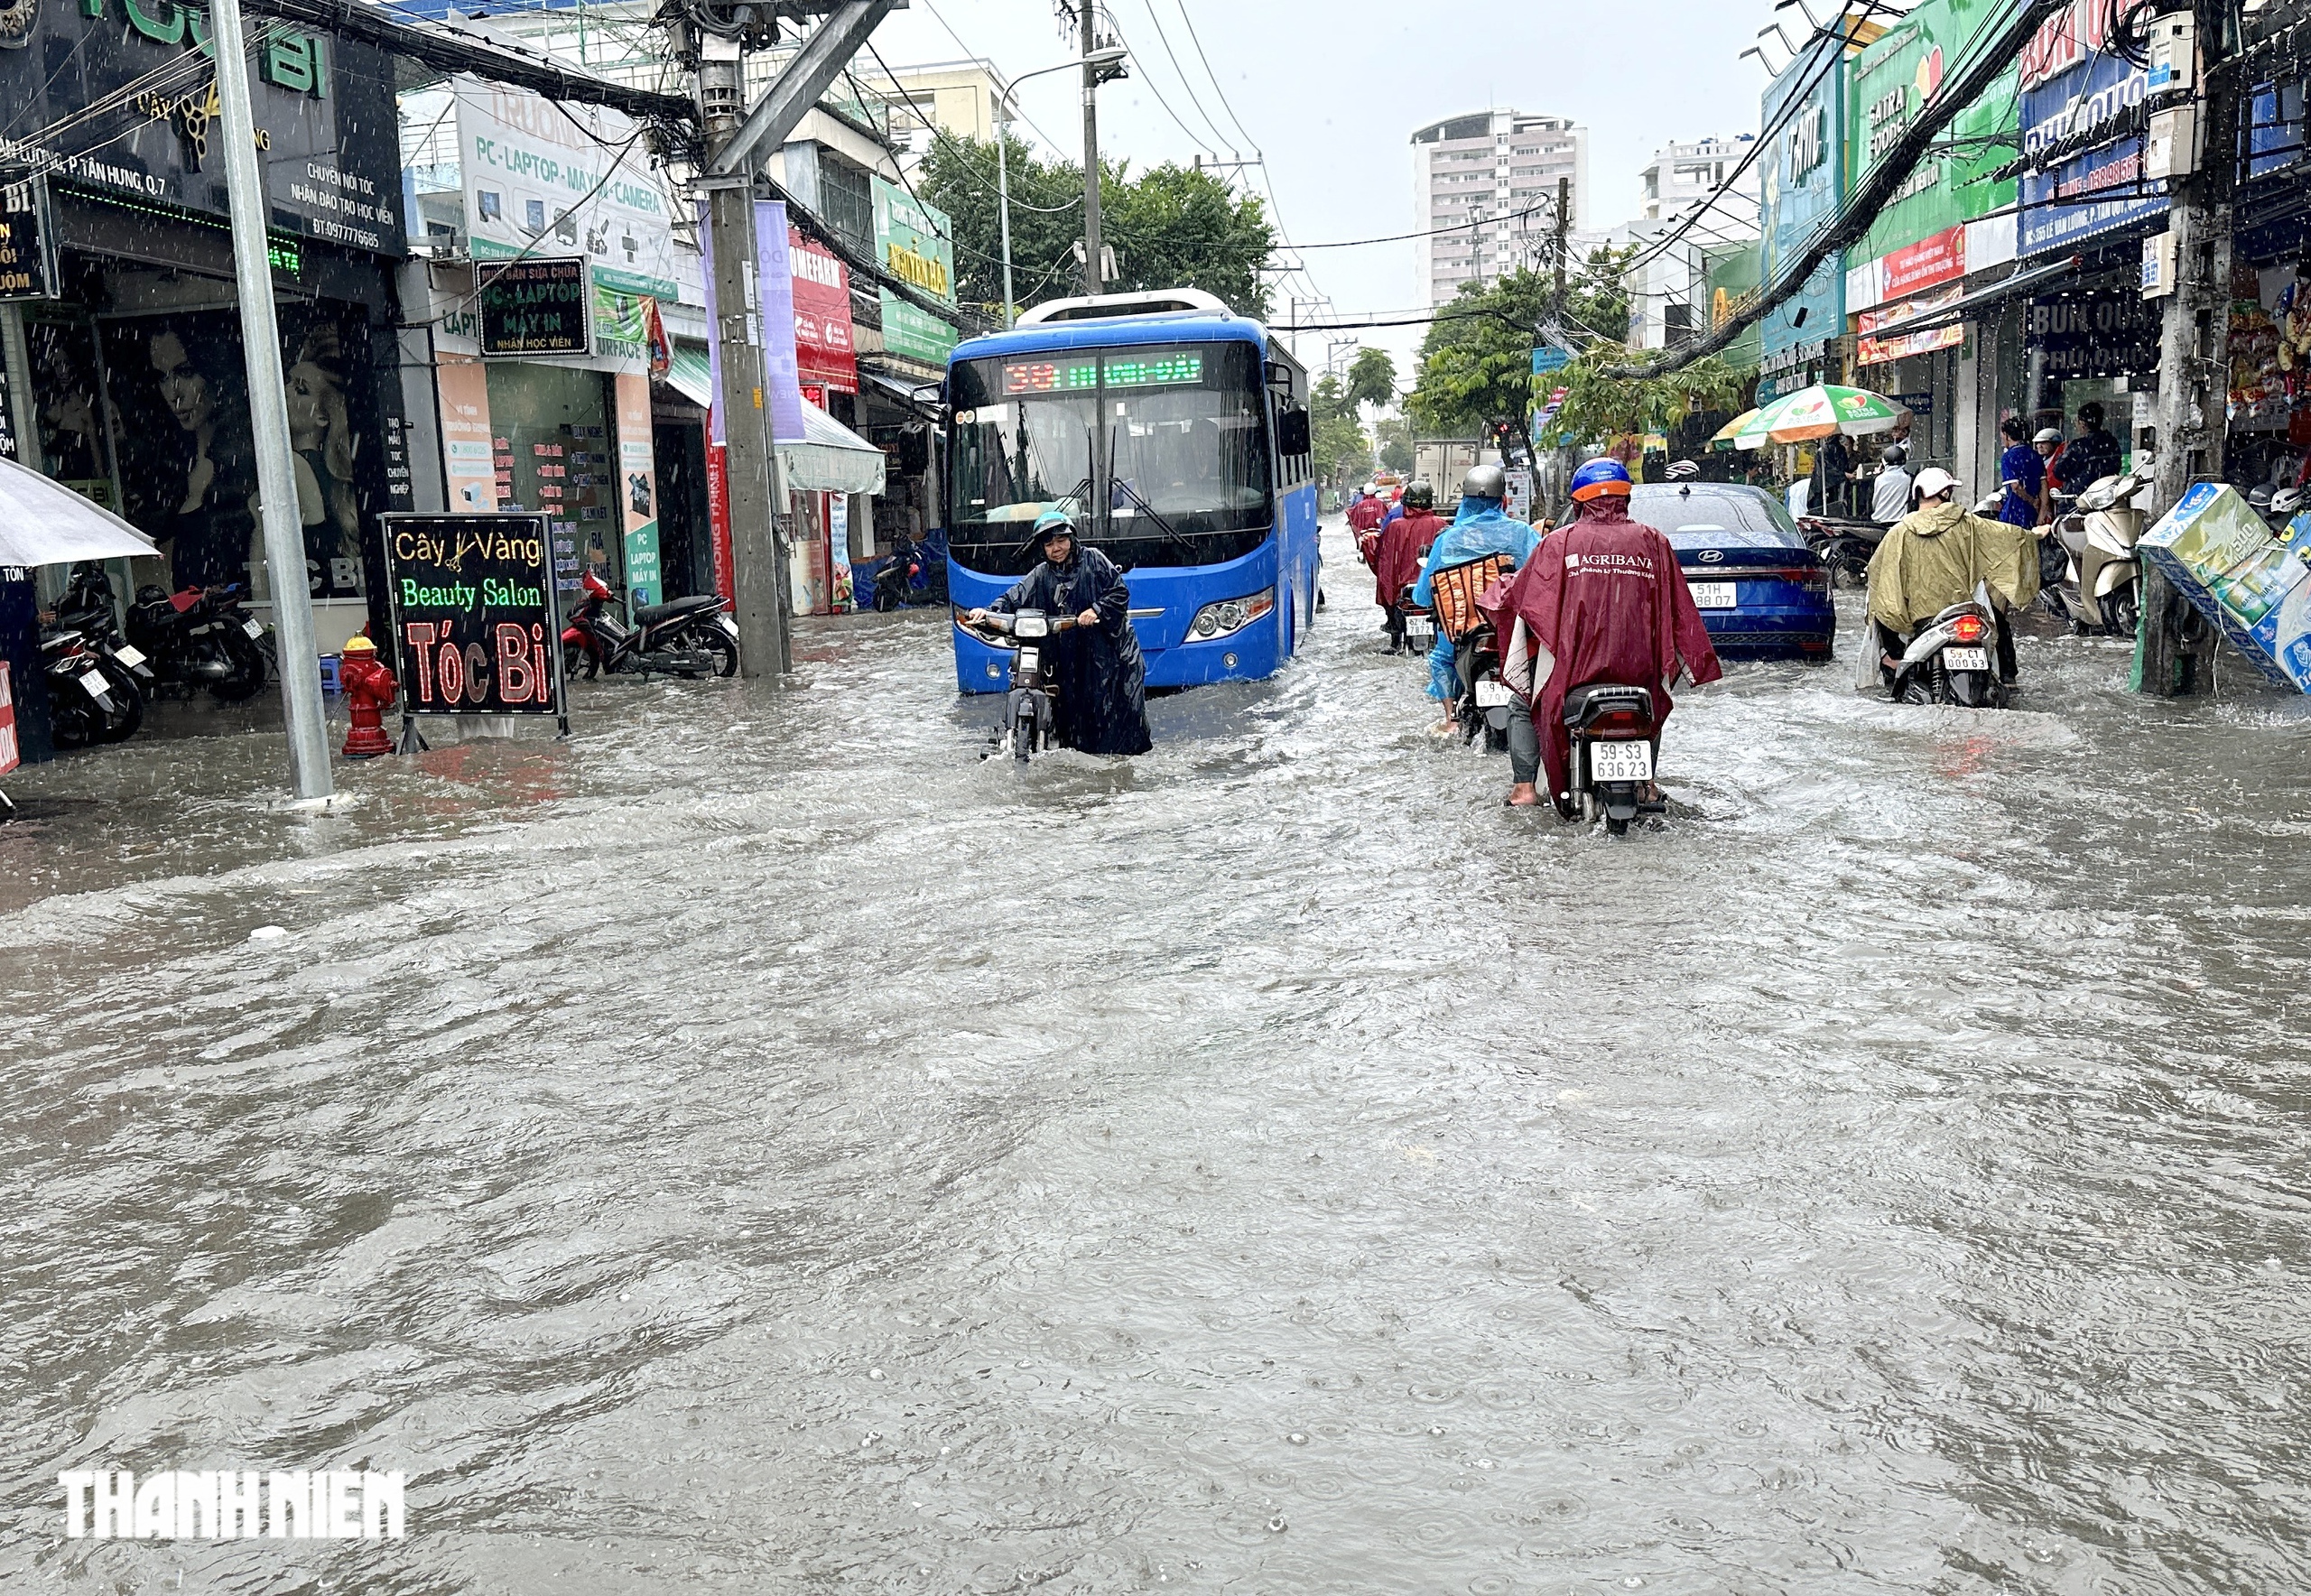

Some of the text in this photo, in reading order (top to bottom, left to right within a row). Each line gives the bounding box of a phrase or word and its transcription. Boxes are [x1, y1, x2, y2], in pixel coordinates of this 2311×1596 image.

[307, 162, 341, 187] CHUYÊN
[358, 176, 375, 195] TÓC
[291, 183, 394, 226] NHẬN ĐÀO TẠO HỌC VIÊN
[516, 283, 581, 303] LAPTOP
[503, 311, 562, 334] MÁY IN
[2033, 298, 2088, 334] BÚN
[526, 338, 548, 349] HỌC
[550, 337, 571, 348] VIÊN
[637, 534, 647, 545] PC
[2232, 523, 2256, 552] 500
[395, 532, 543, 567] Cây Vàng
[631, 552, 656, 564] LAPTOP
[1581, 554, 1654, 569] AGRIBANK
[632, 567, 656, 583] MÁY IN
[402, 579, 543, 612] Beauty Salon
[1697, 583, 1721, 595] 51H
[407, 620, 548, 703] Tóc Bi
[1950, 649, 1979, 659] 59-C1
[1600, 745, 1642, 761] 59-S3
